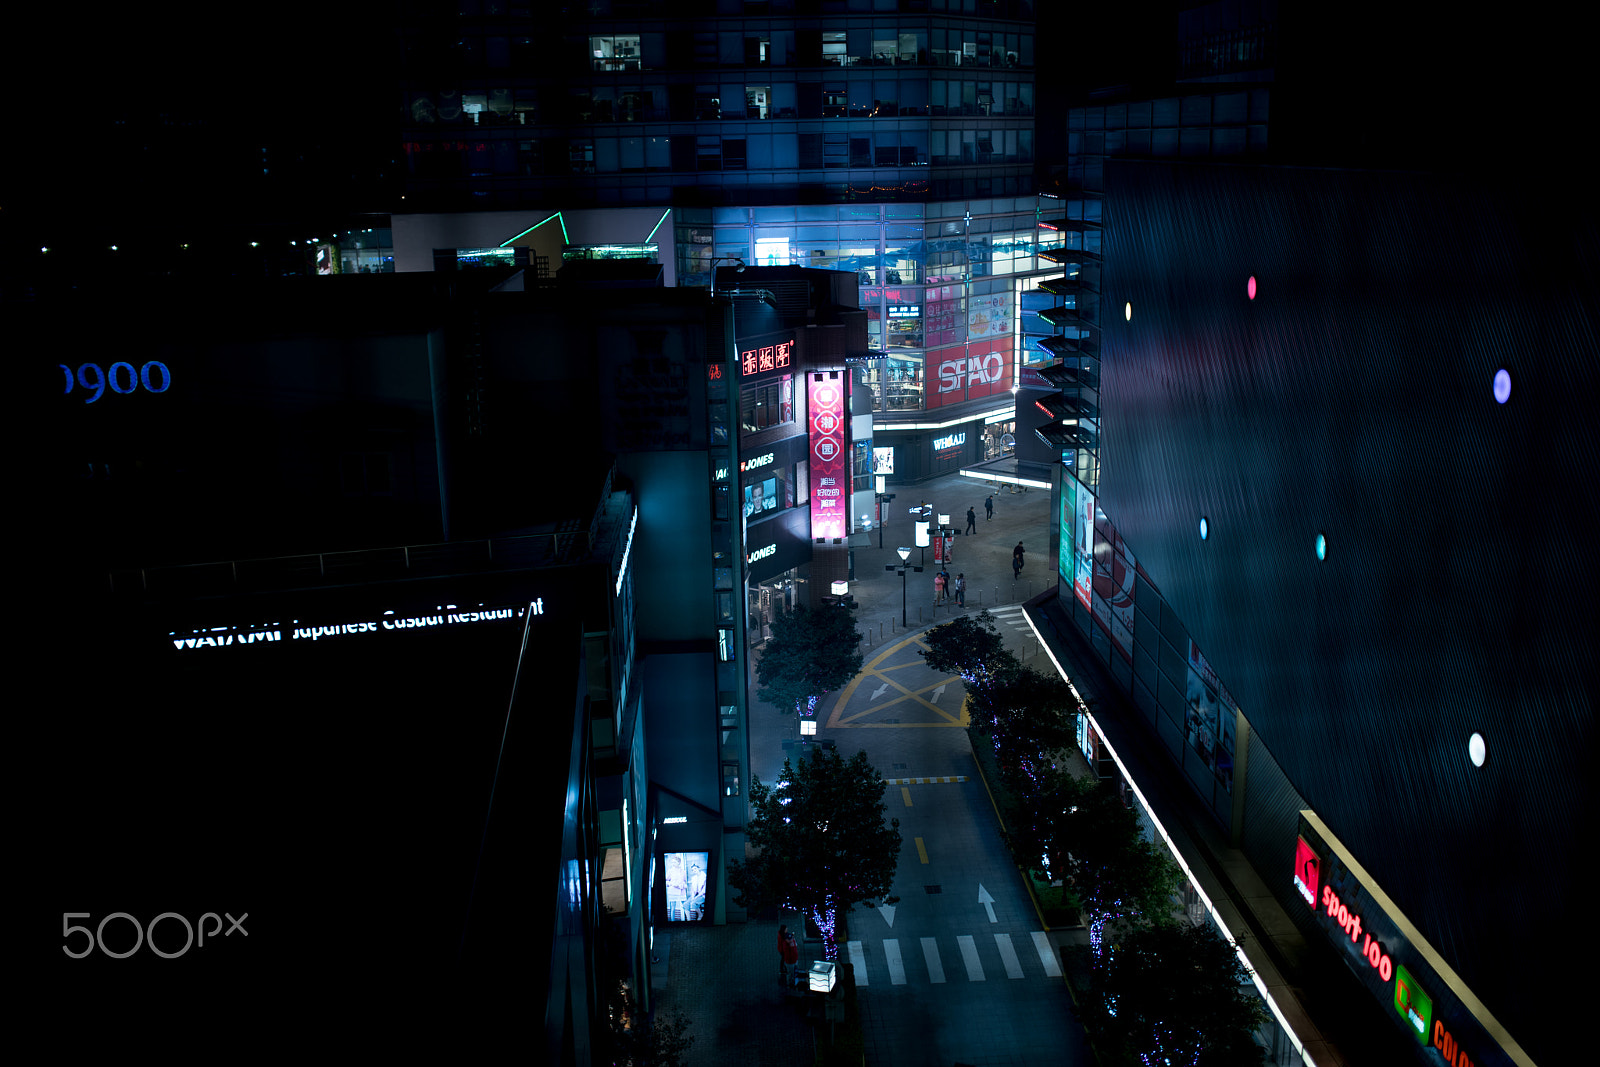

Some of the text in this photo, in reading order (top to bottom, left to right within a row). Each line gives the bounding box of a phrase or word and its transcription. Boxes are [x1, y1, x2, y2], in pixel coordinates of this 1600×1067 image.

[938, 351, 1004, 394] SPAO
[745, 452, 775, 471] JONES
[747, 543, 777, 564] JONES
[1321, 884, 1393, 982] sport 100
[1433, 1019, 1474, 1067] COLO
